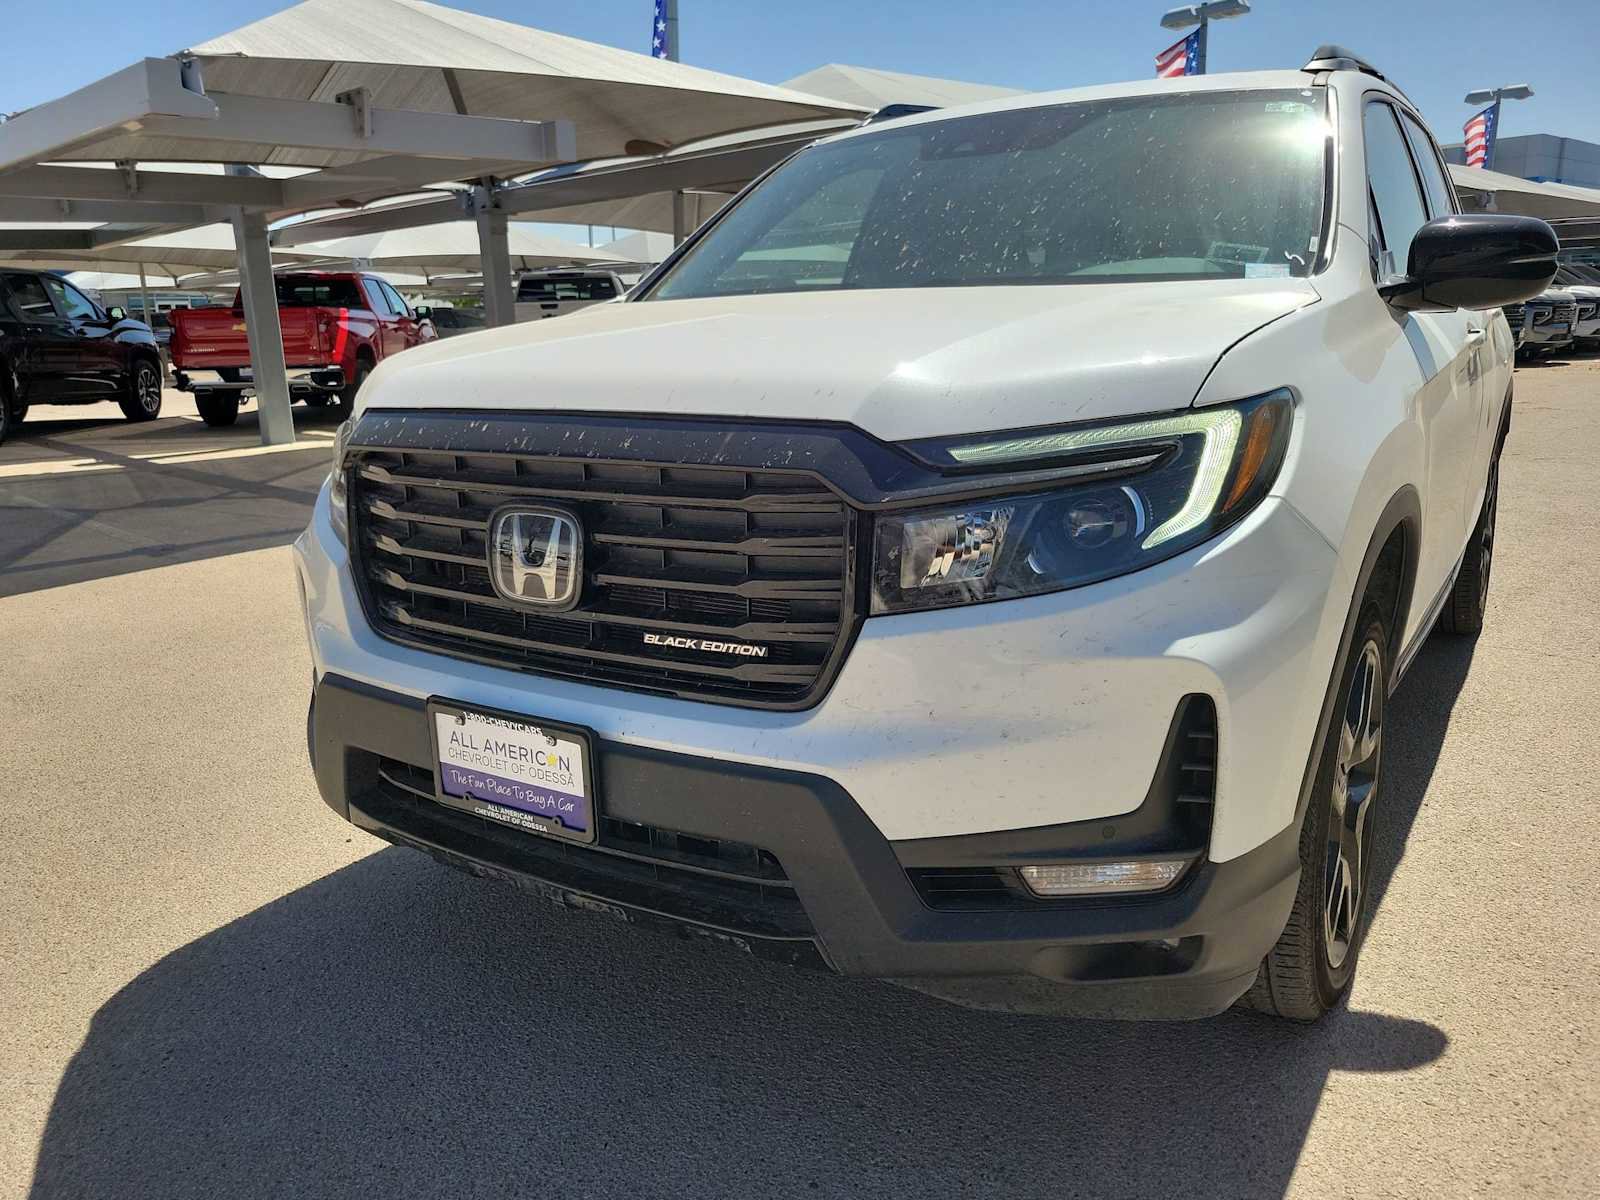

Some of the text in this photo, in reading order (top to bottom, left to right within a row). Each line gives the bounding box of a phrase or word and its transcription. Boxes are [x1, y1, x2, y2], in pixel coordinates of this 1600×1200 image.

[643, 633, 768, 657] BLACK EDITION
[448, 747, 575, 788] CHEVROLET OF ODESSA
[449, 730, 571, 773] ALL AMERICN
[450, 769, 468, 785] The
[486, 778, 512, 796] Place
[512, 785, 525, 800] To
[525, 790, 546, 809] Buy
[547, 795, 557, 809] A
[557, 797, 575, 812] Car
[474, 807, 548, 833] CHEVROLET OF ODESSA
[487, 804, 534, 822] ALL AMERICAN
